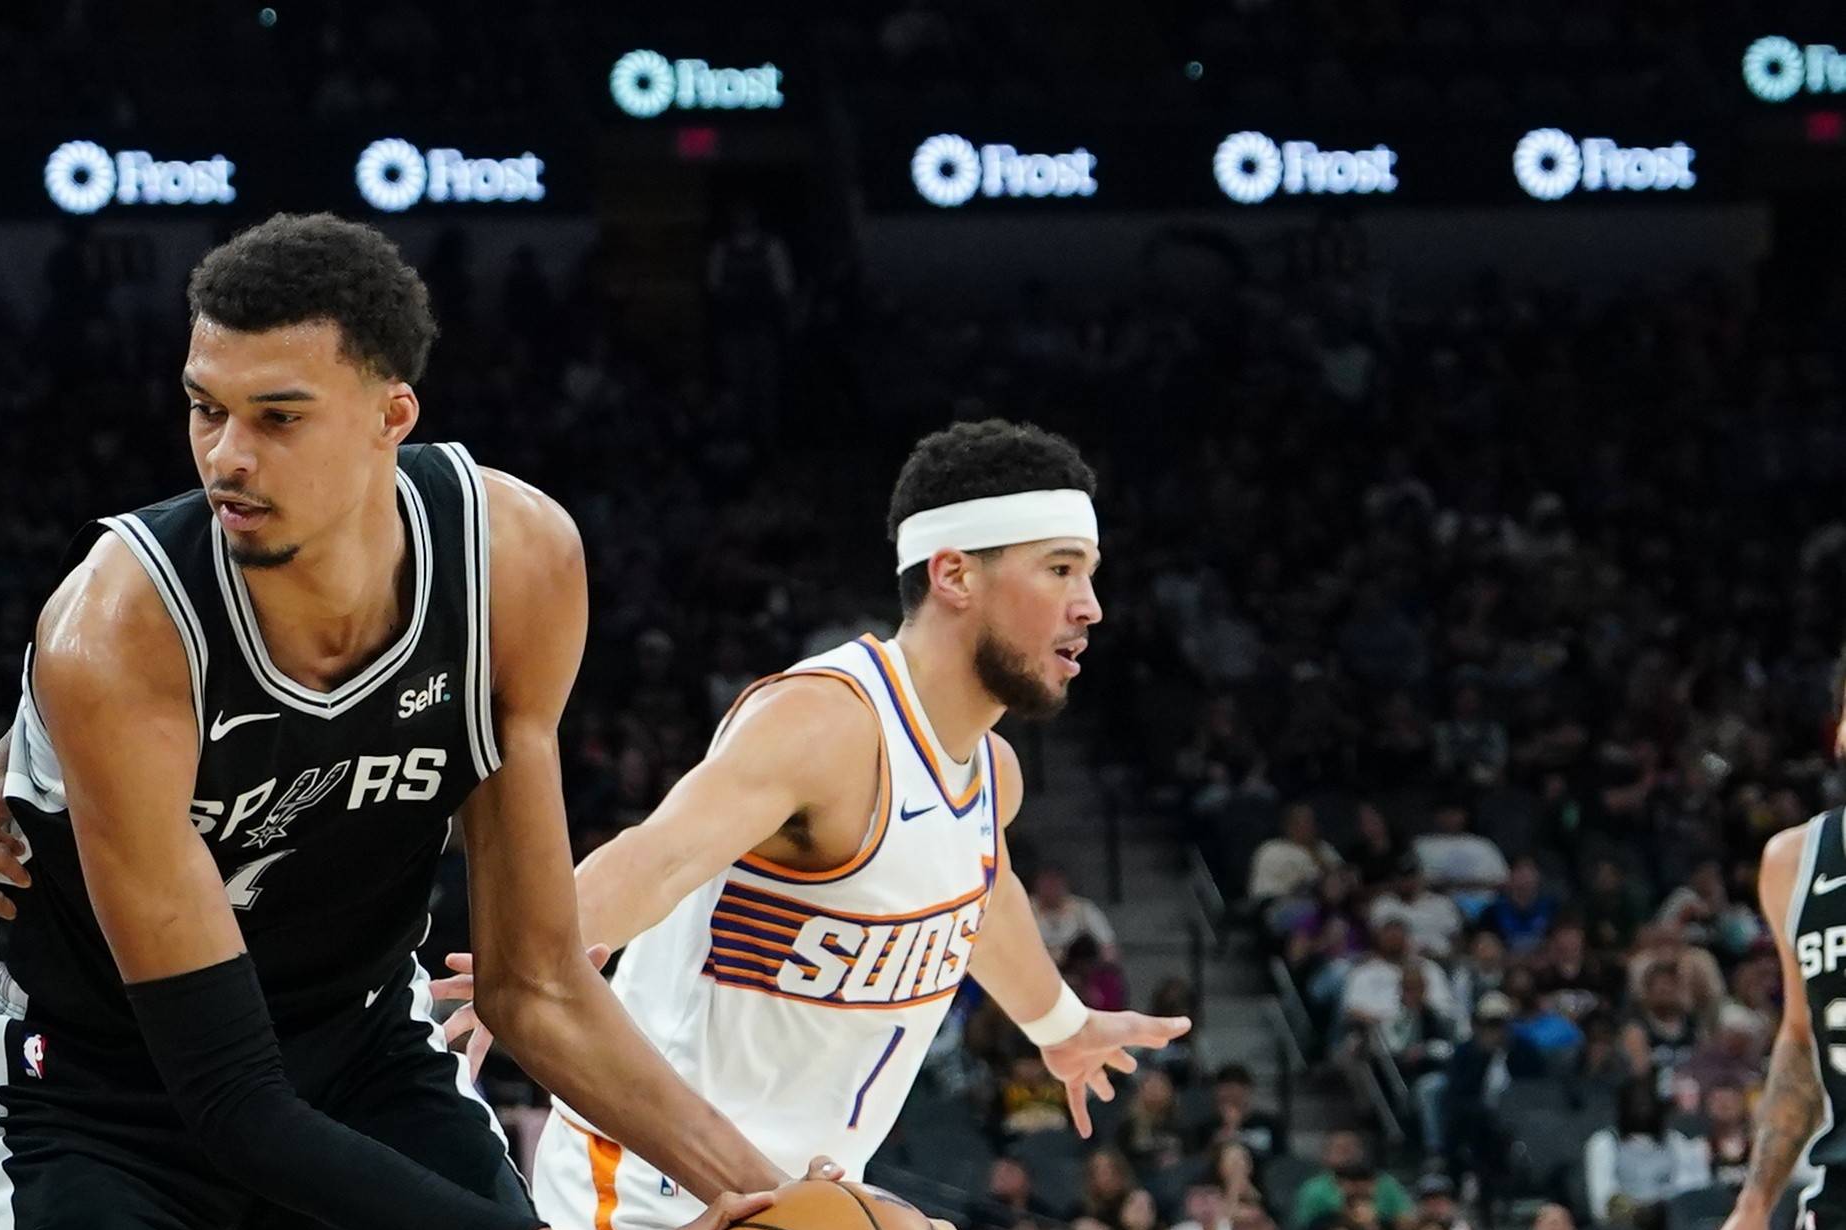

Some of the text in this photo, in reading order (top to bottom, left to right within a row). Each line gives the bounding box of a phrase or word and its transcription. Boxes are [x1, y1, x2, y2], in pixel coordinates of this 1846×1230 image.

[678, 59, 784, 109] Frost
[117, 151, 236, 204] Frost
[427, 149, 545, 202] Frost
[982, 144, 1098, 197] Frost
[1283, 140, 1399, 194] Frost
[1583, 137, 1697, 191] Frost
[775, 902, 982, 1002] SUNS
